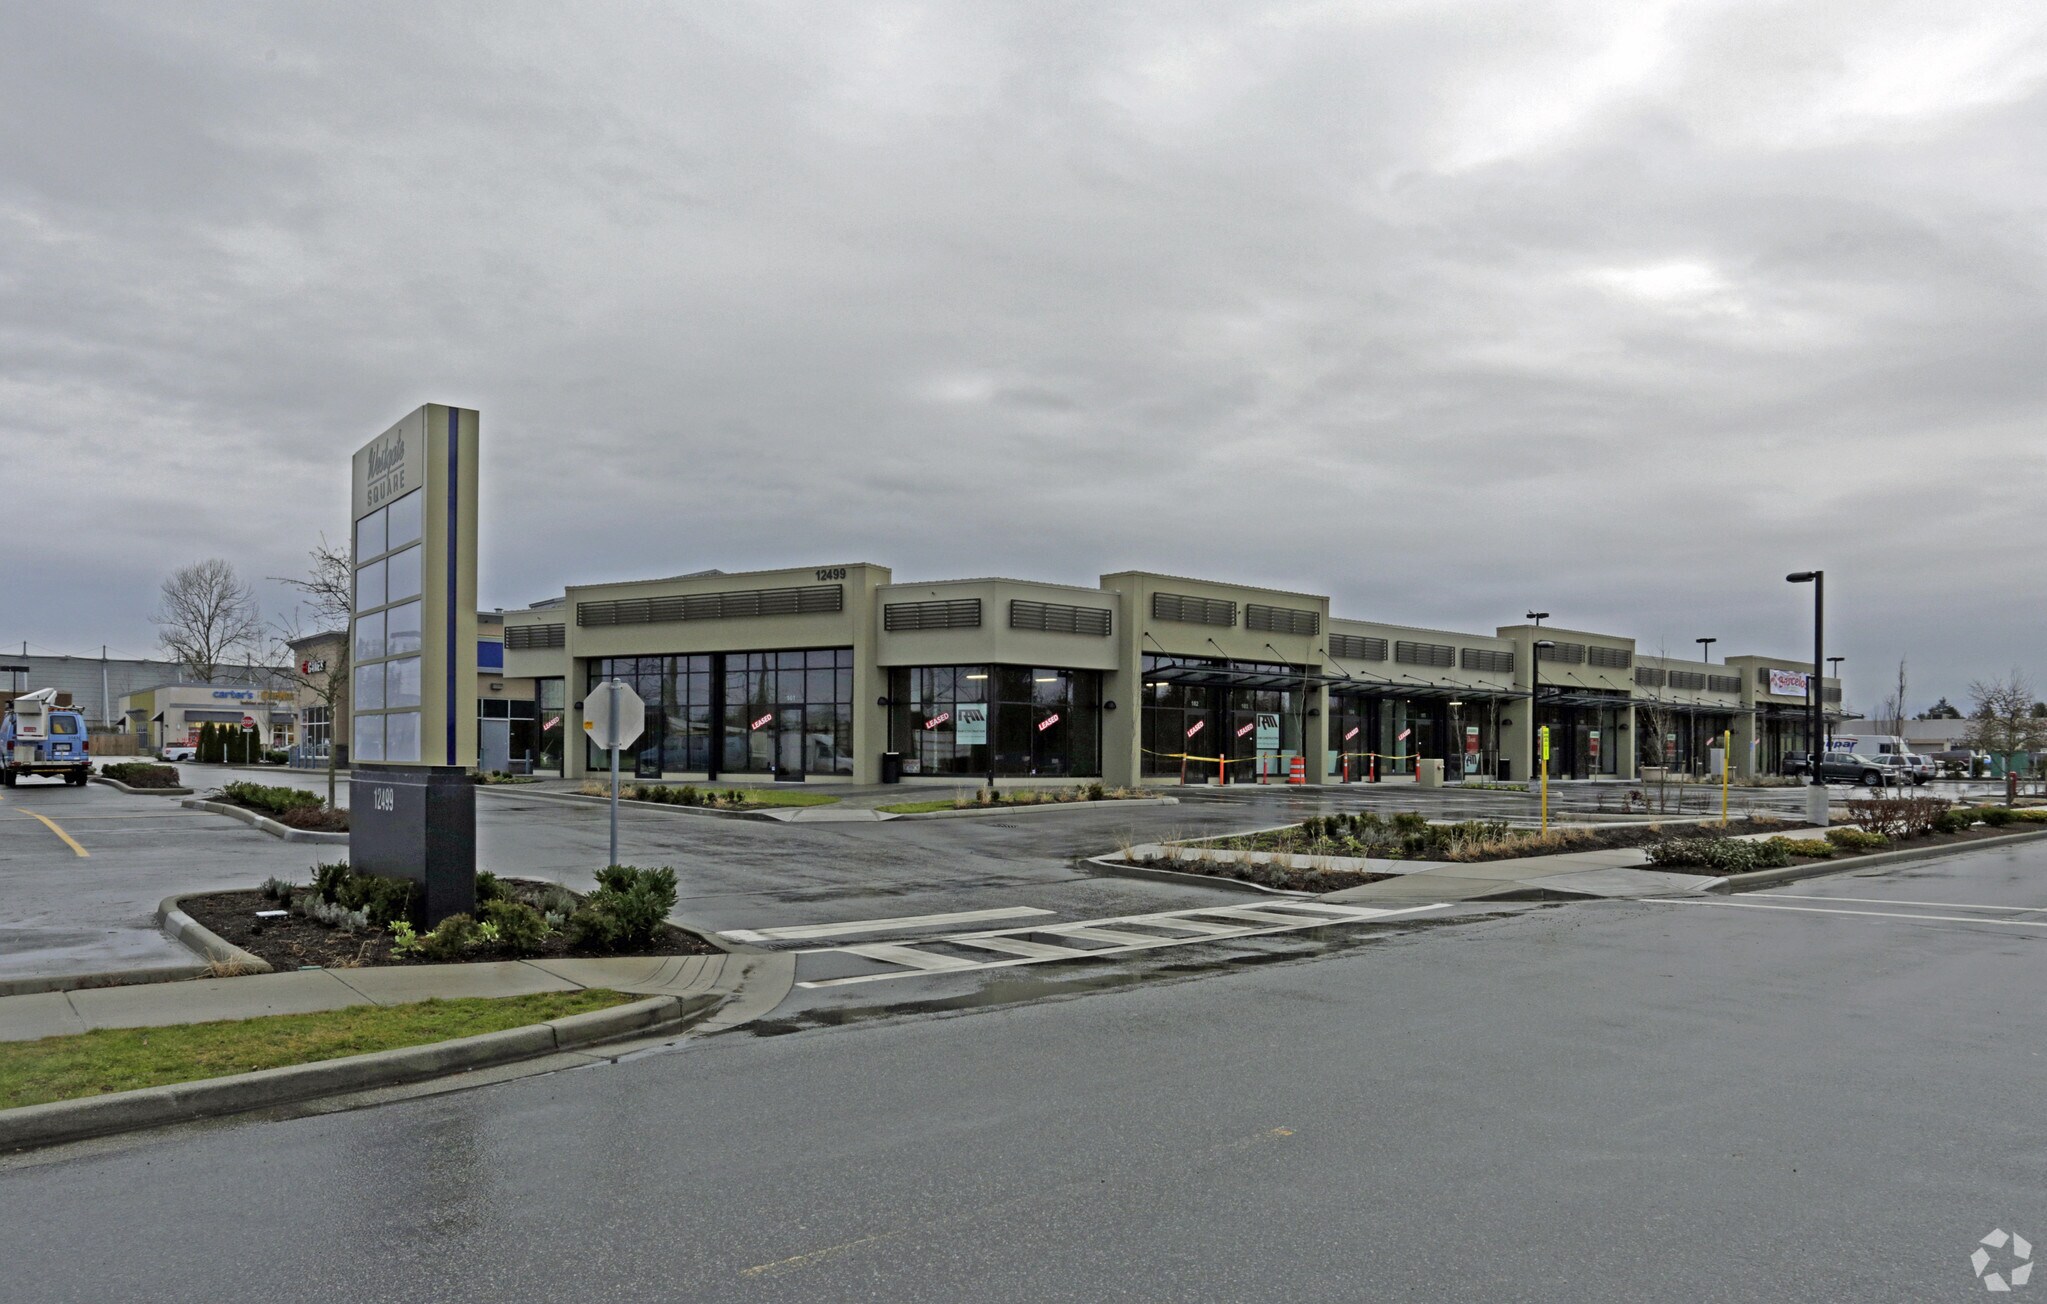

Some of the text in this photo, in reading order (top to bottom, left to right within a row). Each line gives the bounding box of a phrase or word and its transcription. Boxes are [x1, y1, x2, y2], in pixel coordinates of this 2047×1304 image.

[367, 469, 405, 507] SQUARE
[815, 567, 847, 581] 12499
[212, 690, 253, 700] carter's
[543, 716, 560, 731] LEASED
[751, 713, 772, 730] LEASED
[925, 712, 950, 729] LEASED
[958, 709, 985, 724] RAM
[1038, 713, 1059, 731] LEASED
[1257, 715, 1278, 730] RAM
[1187, 720, 1204, 738] LEASED
[1237, 723, 1254, 737] LEASED
[1345, 726, 1359, 741] LEASED
[1397, 728, 1411, 741] LEASED
[373, 787, 394, 811] 12499
